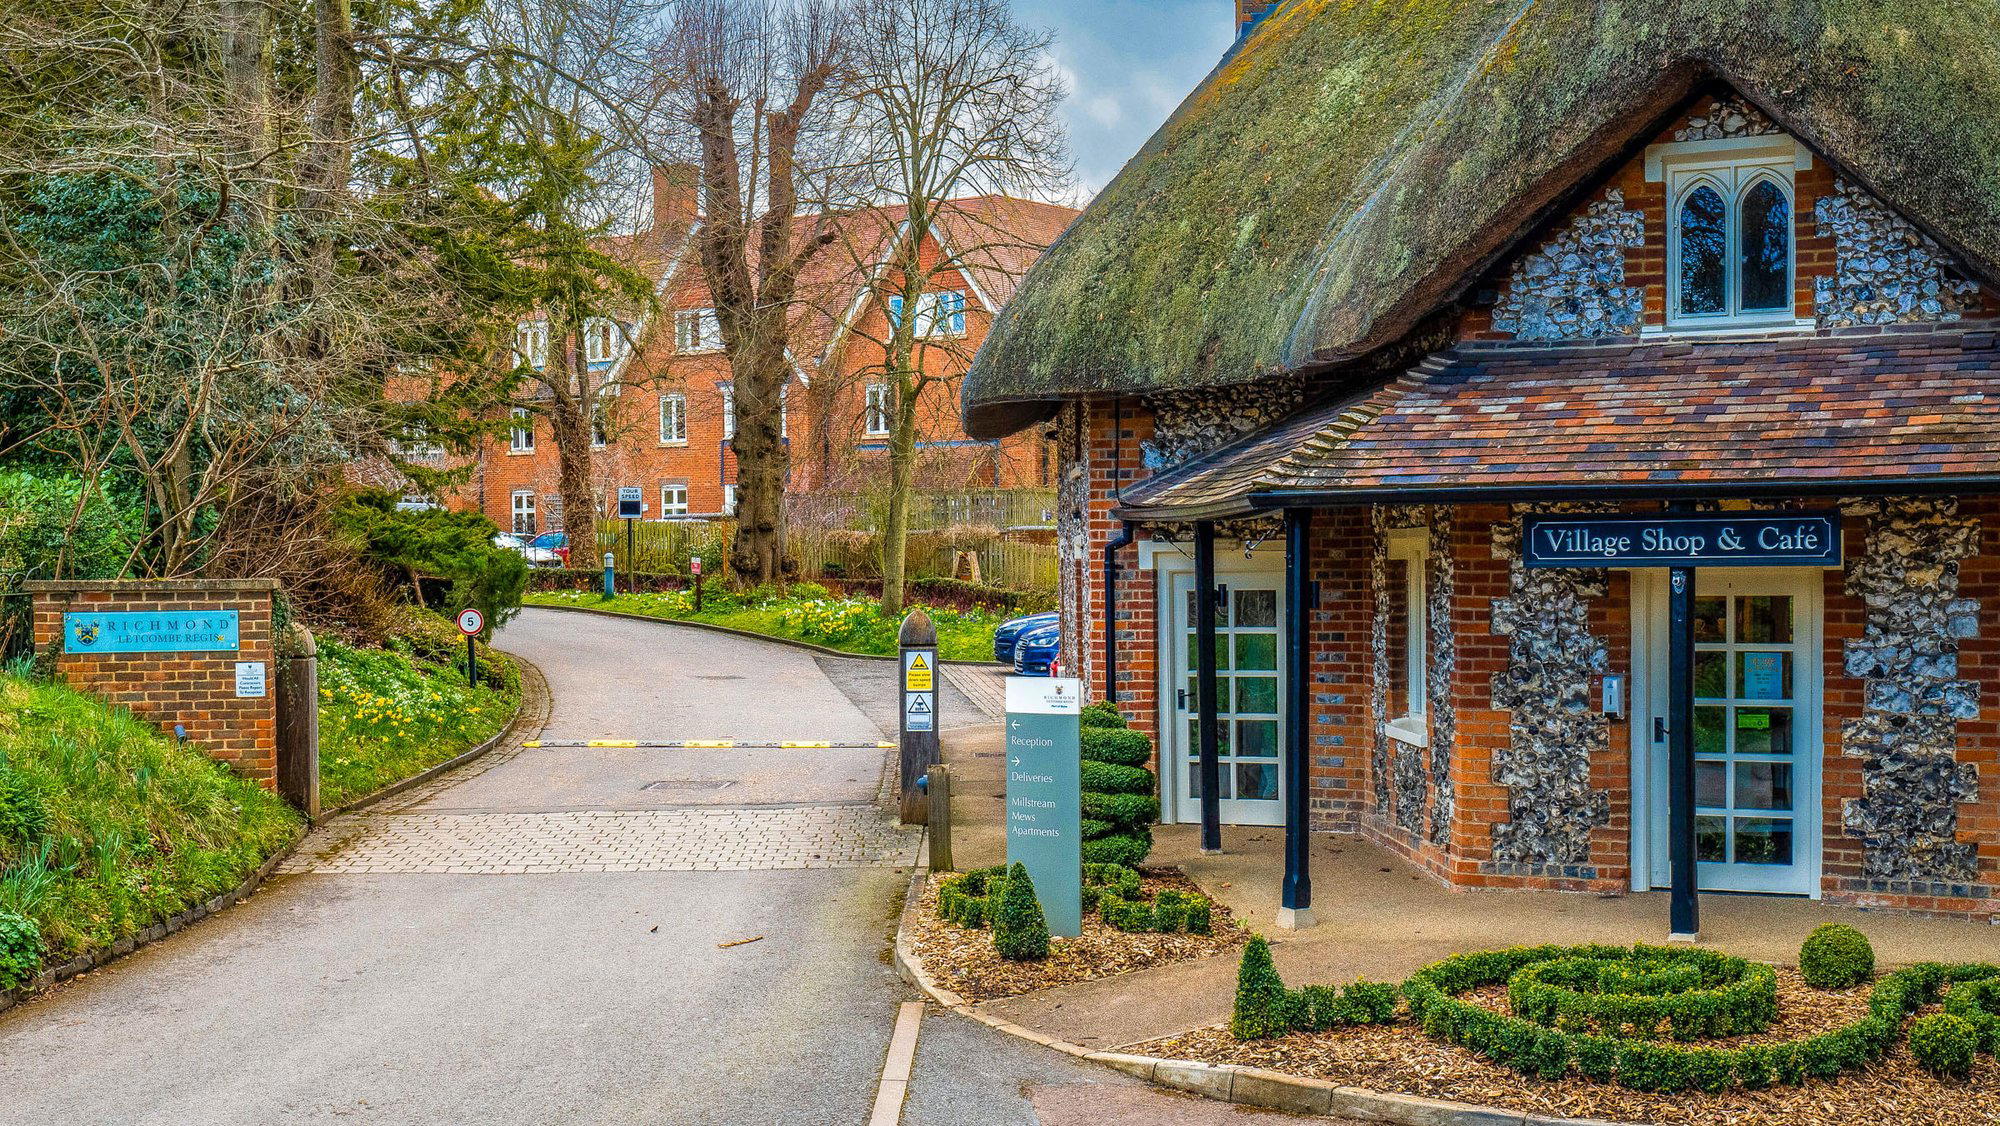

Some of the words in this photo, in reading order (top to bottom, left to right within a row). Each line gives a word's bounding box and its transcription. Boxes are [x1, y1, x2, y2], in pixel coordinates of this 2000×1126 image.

[1544, 528, 1631, 556] Village
[1642, 528, 1705, 555] Shop
[1716, 527, 1745, 551] &
[1757, 525, 1818, 551] Café
[107, 619, 229, 631] RICHMOND
[467, 617, 474, 626] 5
[118, 634, 182, 644] LETCOMBE
[185, 633, 219, 643] REGIS
[1011, 735, 1053, 749] Reception
[1011, 771, 1053, 783] Deliveries
[1011, 797, 1056, 808] Millstream
[1011, 811, 1036, 821] Mews
[1011, 826, 1060, 837] Apartments
